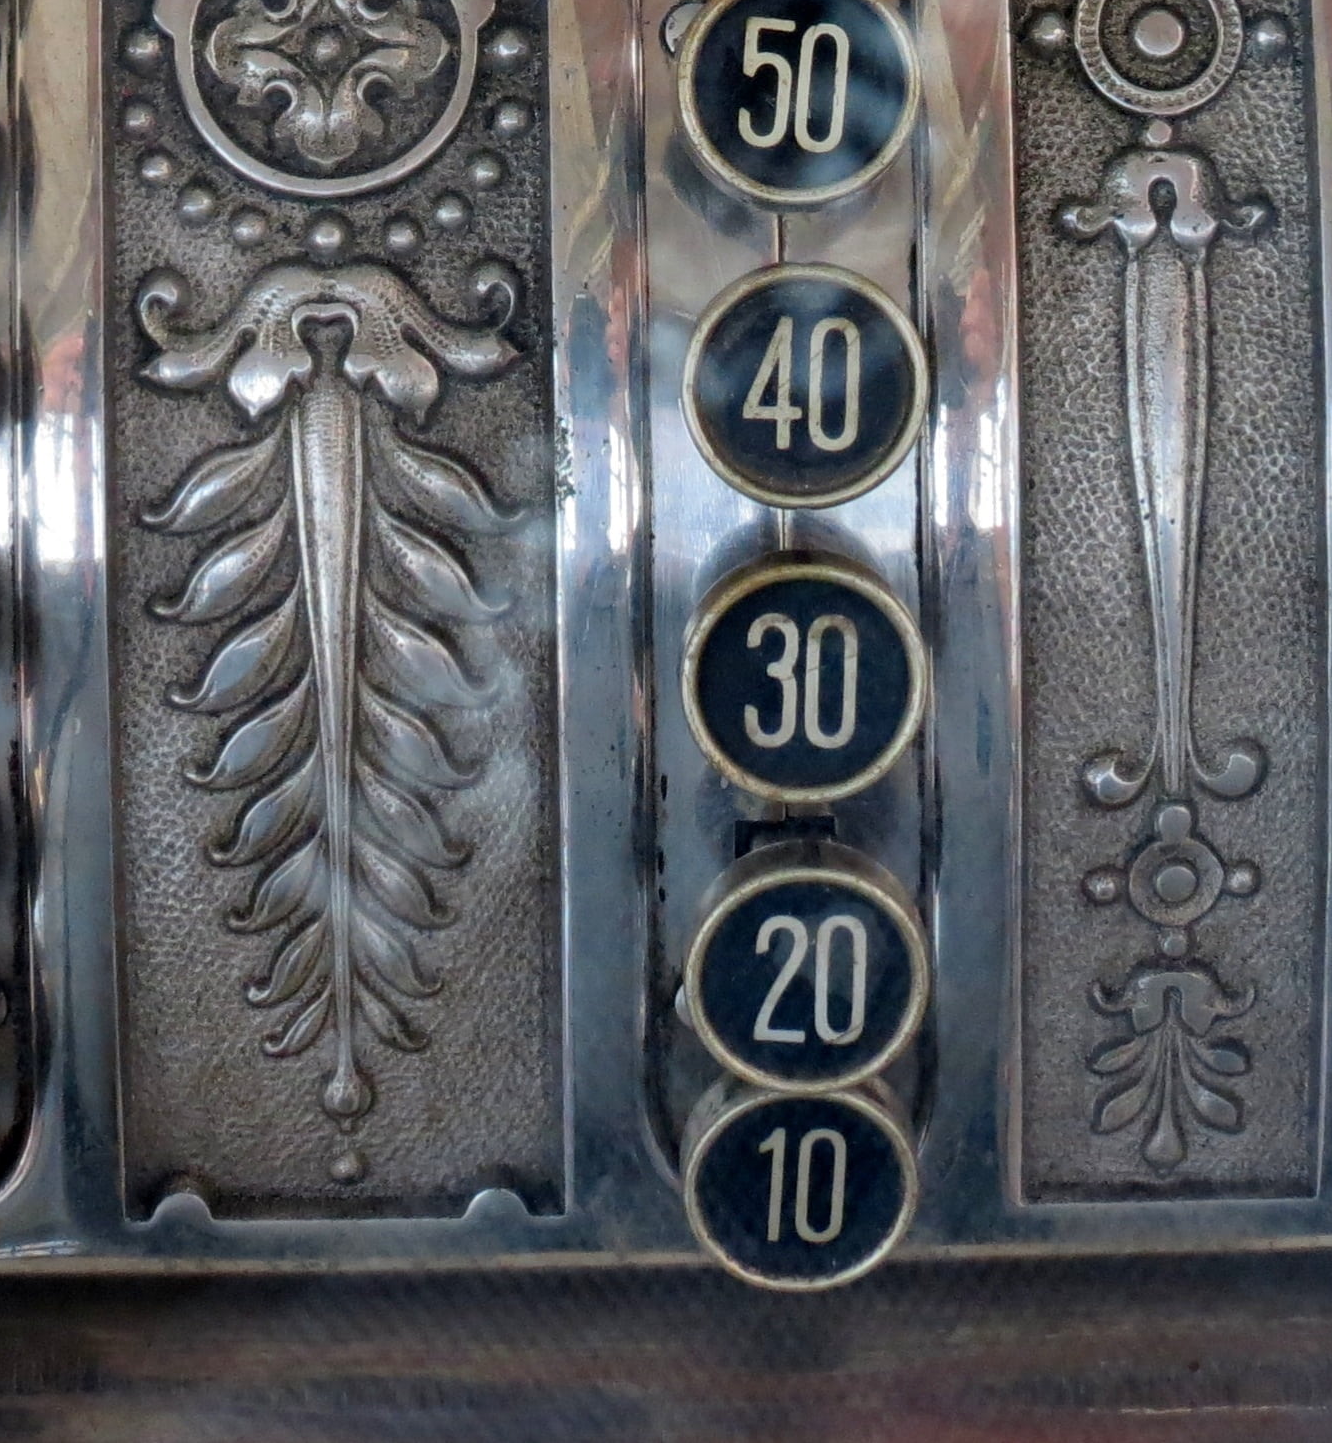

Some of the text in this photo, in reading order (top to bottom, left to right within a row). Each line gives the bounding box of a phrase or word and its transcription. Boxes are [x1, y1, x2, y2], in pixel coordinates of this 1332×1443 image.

[739, 17, 853, 153] 50
[743, 317, 861, 451] 40
[745, 613, 858, 749] 30
[754, 914, 867, 1044] 20
[759, 1128, 846, 1242] 10
